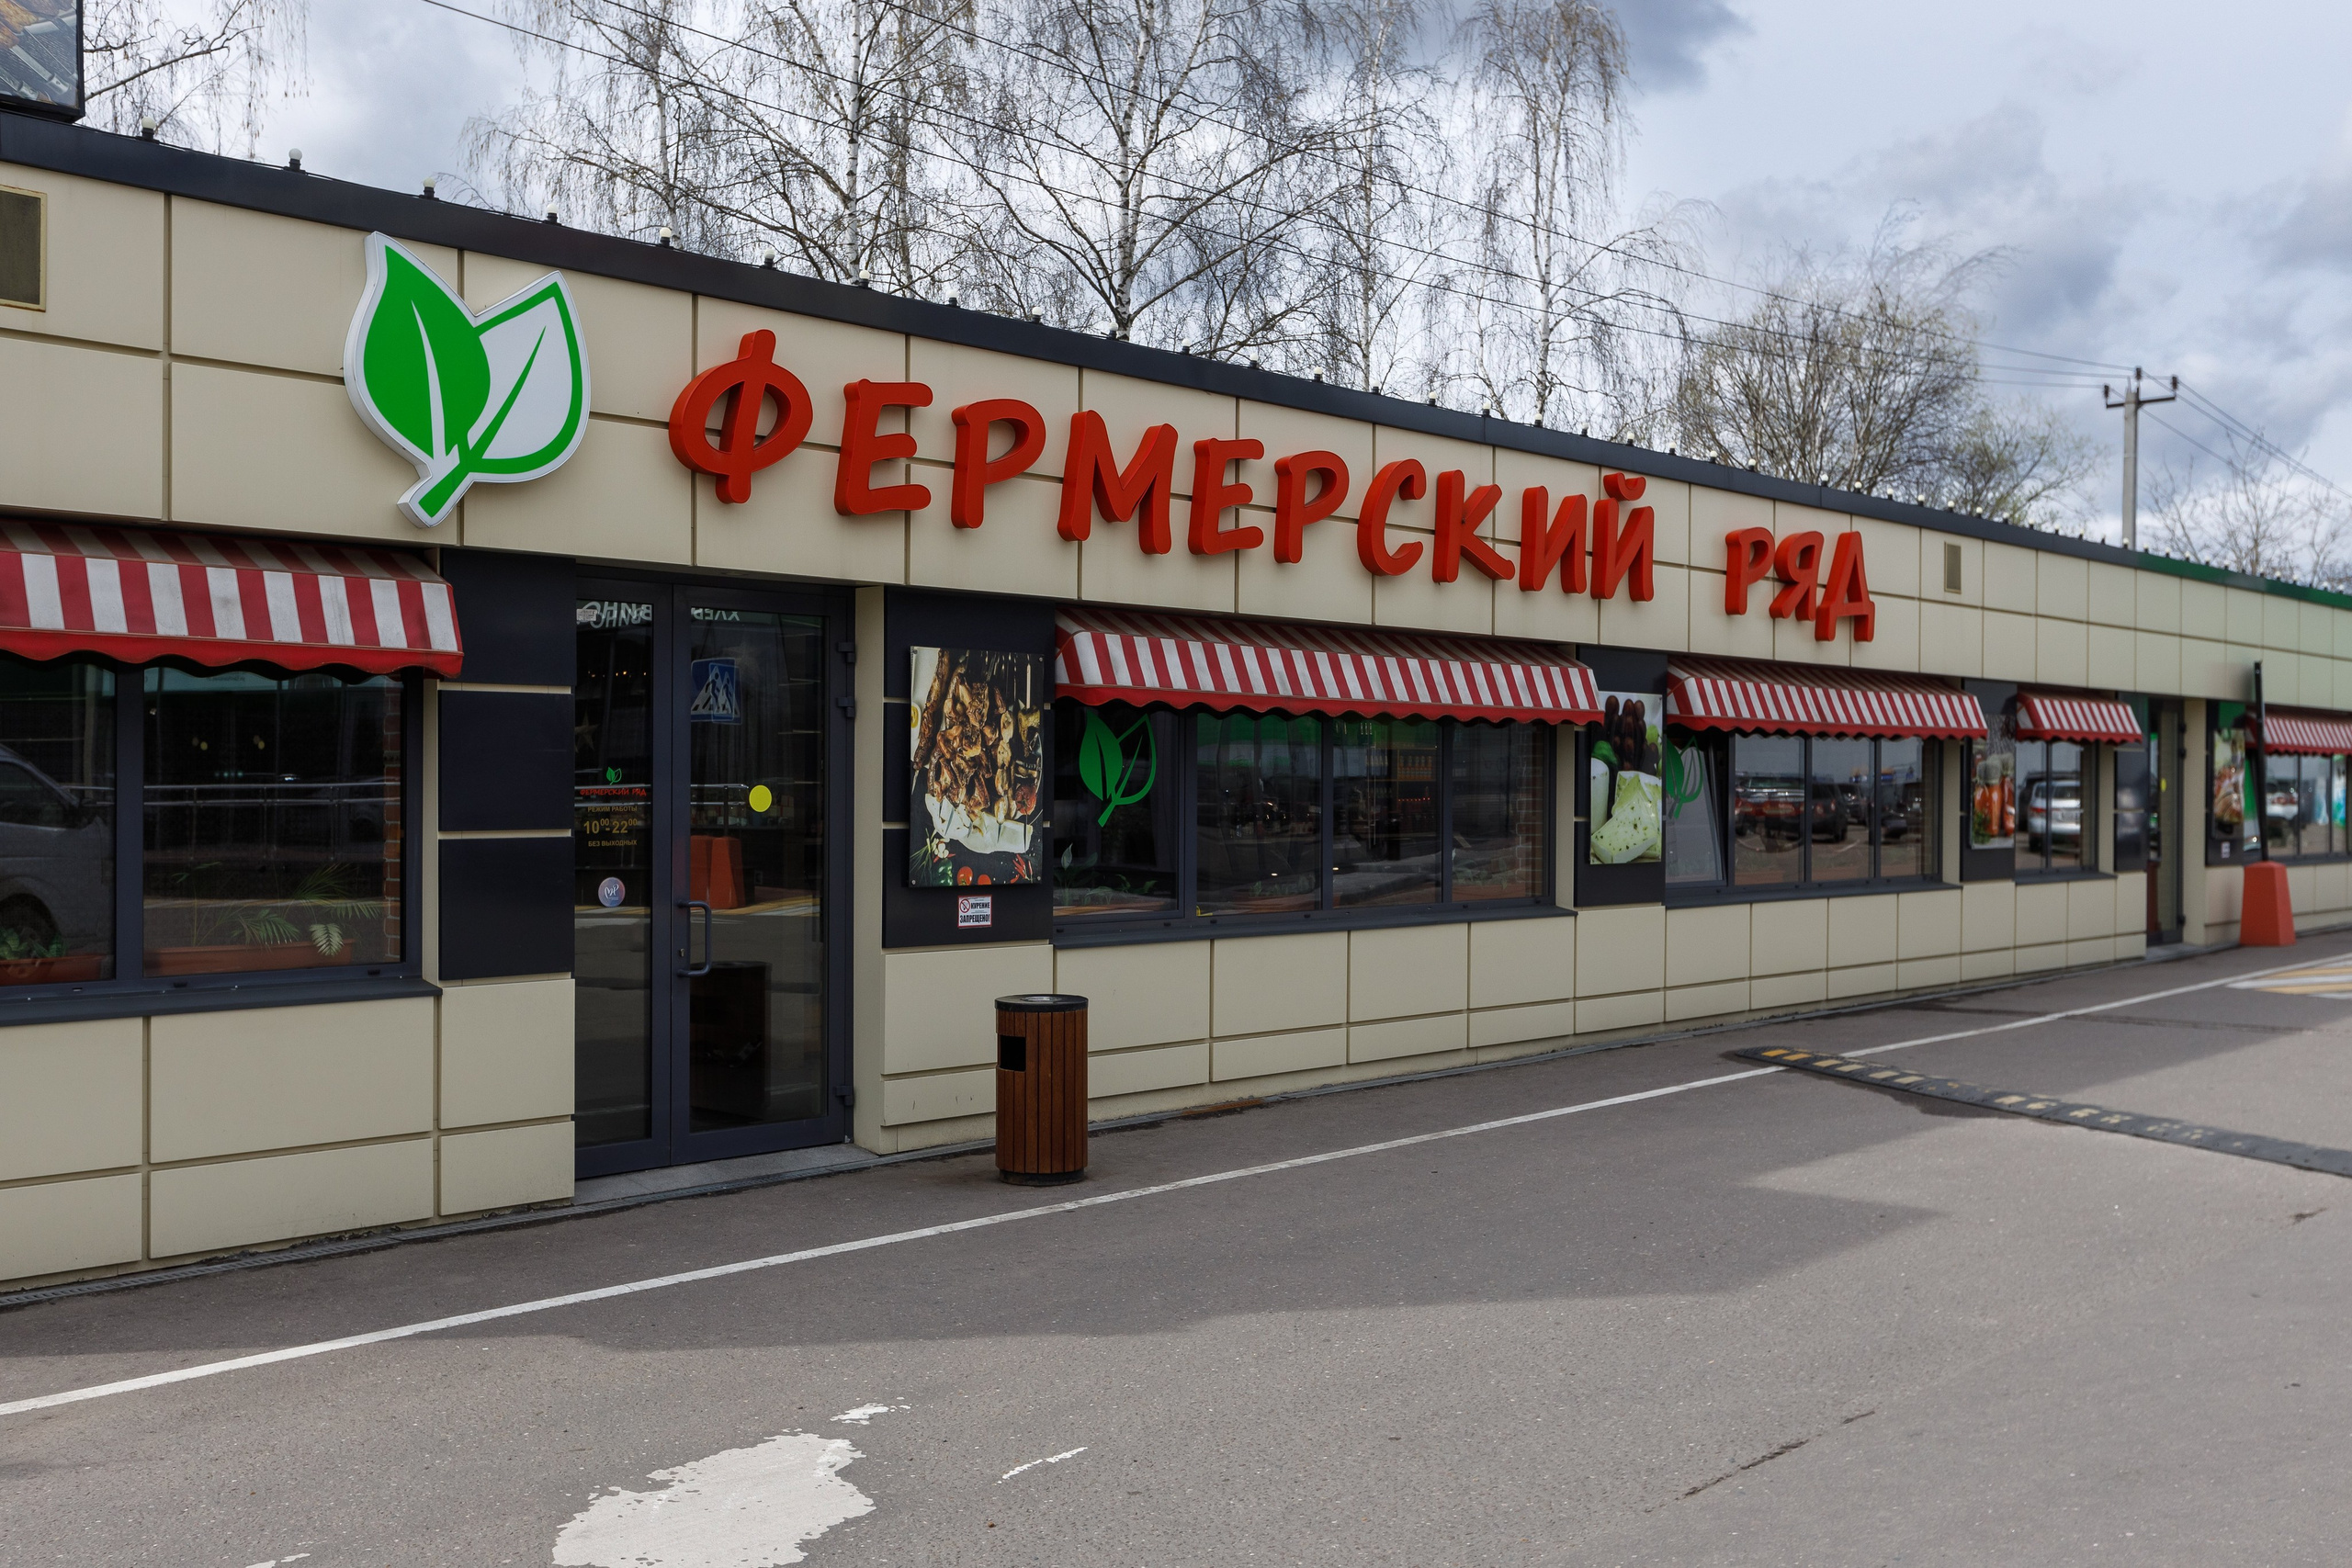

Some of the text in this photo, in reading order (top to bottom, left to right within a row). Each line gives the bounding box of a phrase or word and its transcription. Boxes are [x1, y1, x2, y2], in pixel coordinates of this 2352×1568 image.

[668, 329, 1875, 643] ФЕРМЕРСКИЙ РЯД
[580, 787, 647, 796] ФЕРМЕРСКИЙ РЯД
